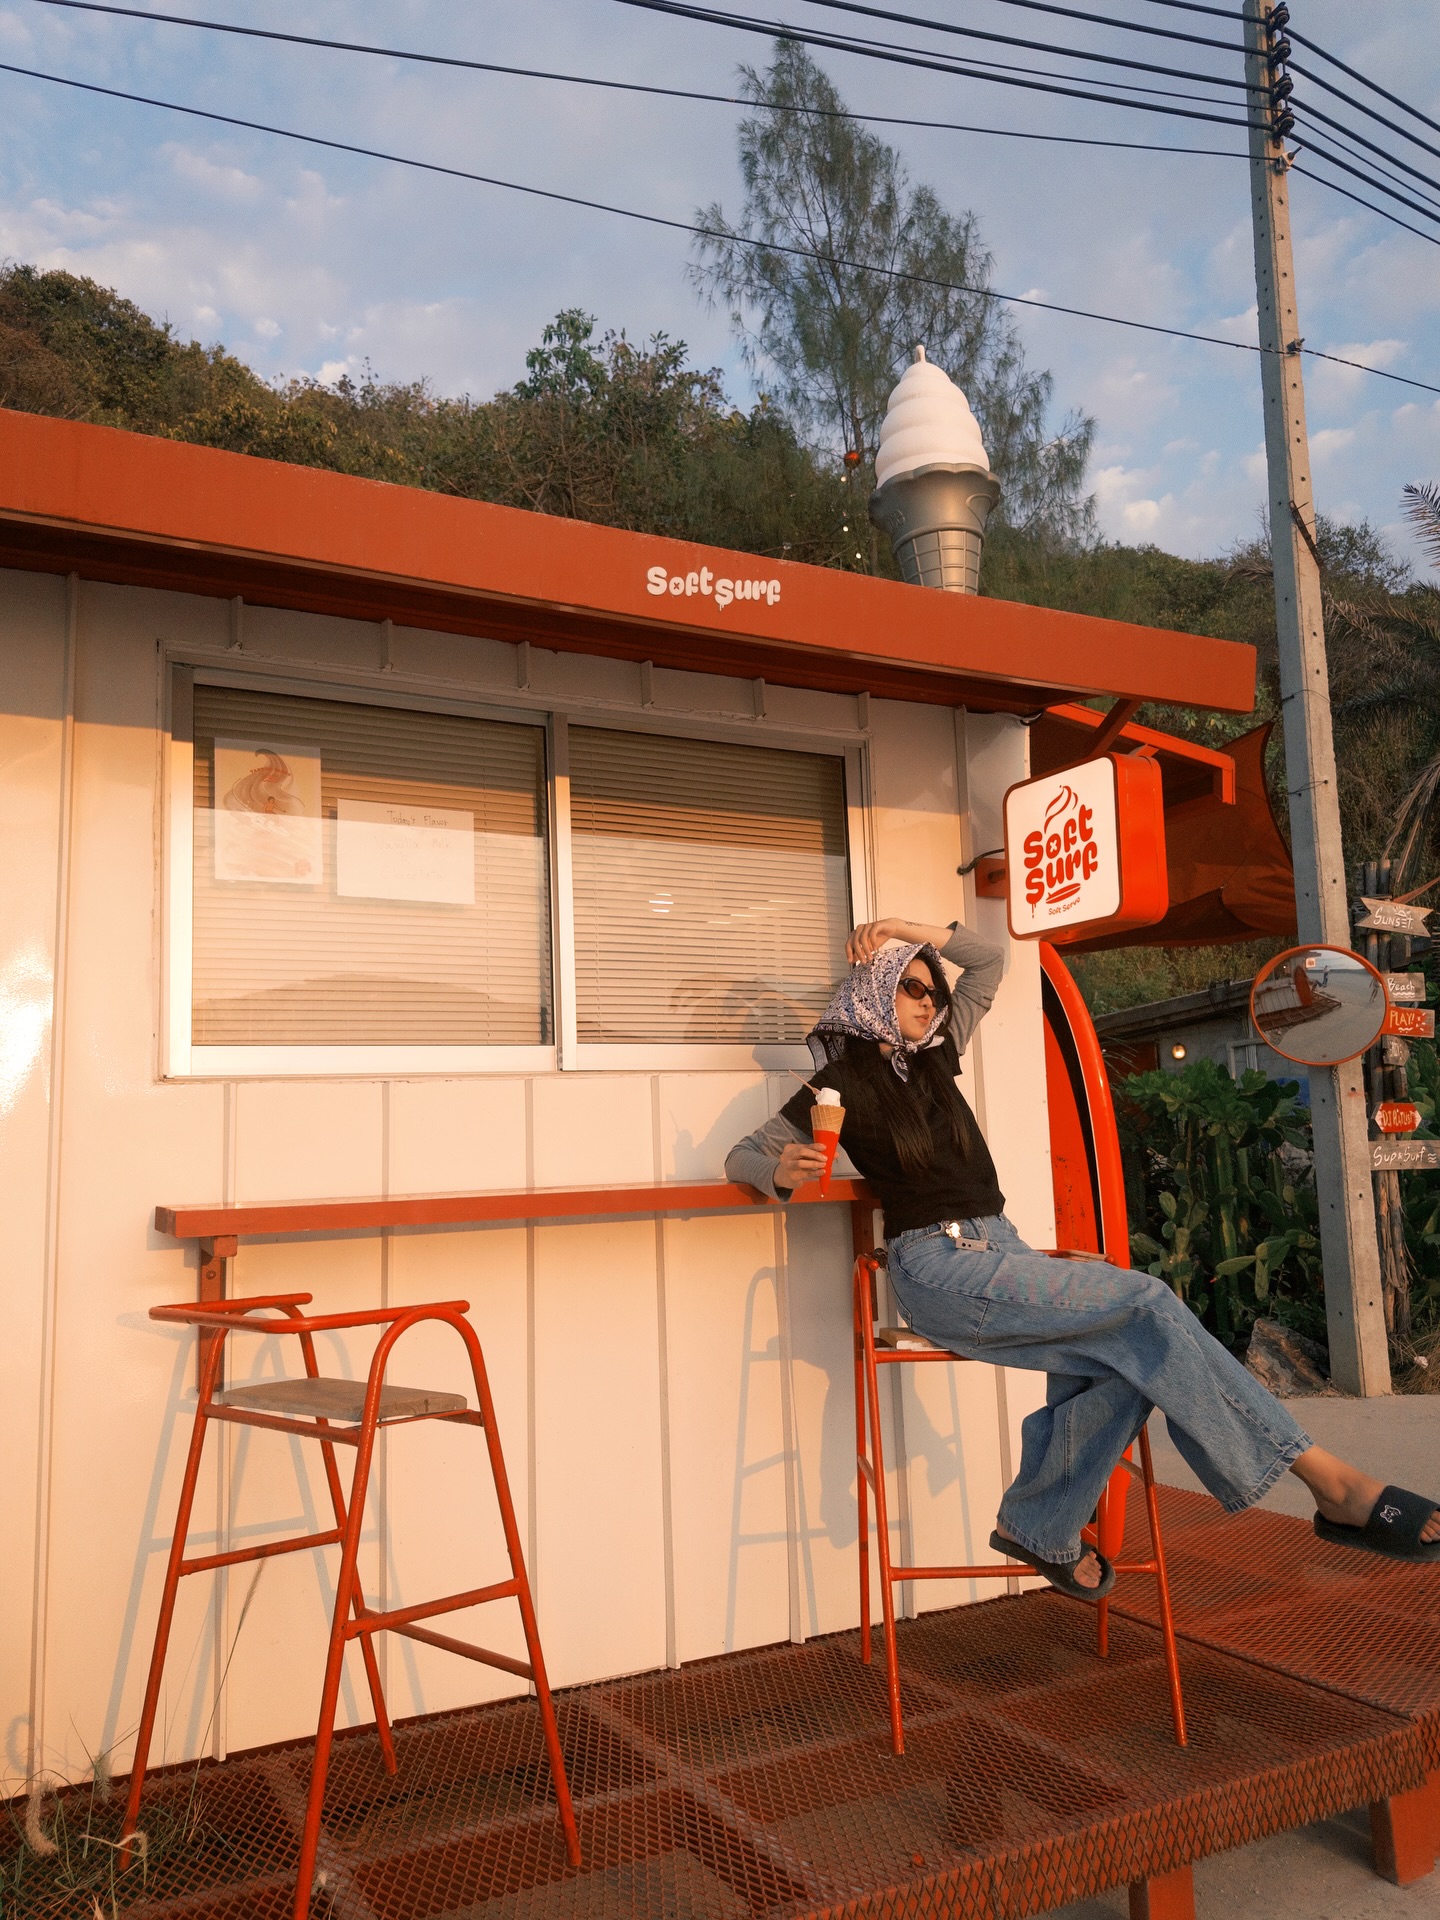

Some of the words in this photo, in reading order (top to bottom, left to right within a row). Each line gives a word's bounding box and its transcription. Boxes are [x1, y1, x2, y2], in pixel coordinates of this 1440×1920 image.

[646, 566, 714, 597] Soft
[1023, 803, 1094, 869] Soft
[1048, 905, 1062, 916] Soft
[1062, 897, 1081, 912] Serve
[1387, 977, 1415, 993] Beach
[1389, 1010, 1416, 1028] PLAY!
